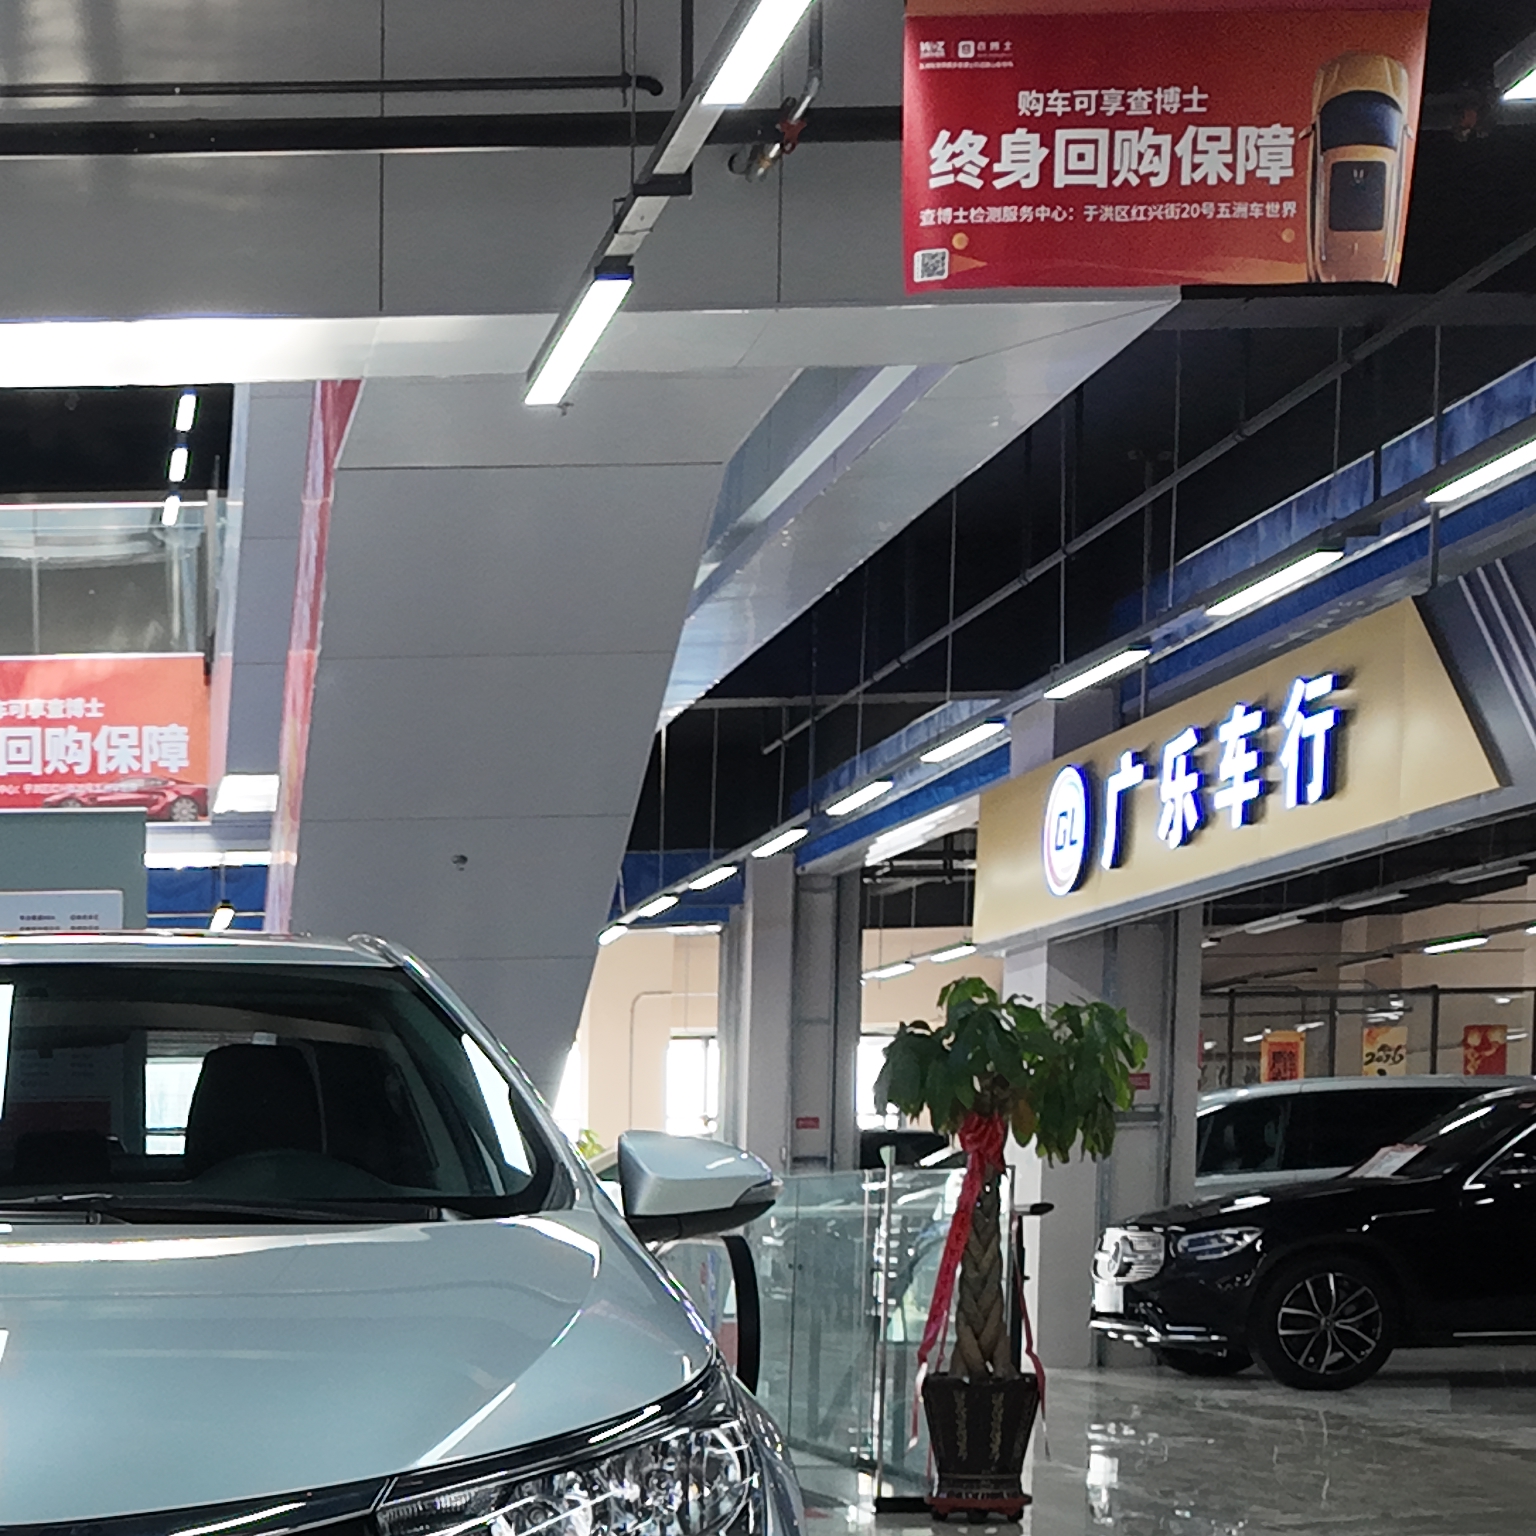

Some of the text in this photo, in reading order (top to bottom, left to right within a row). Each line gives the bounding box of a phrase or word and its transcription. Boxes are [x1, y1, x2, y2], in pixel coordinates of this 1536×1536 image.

[1017, 86, 1209, 118] 购车可享查博士
[929, 124, 1295, 190] 终身回购保障
[1100, 671, 1345, 870] 广乐车行
